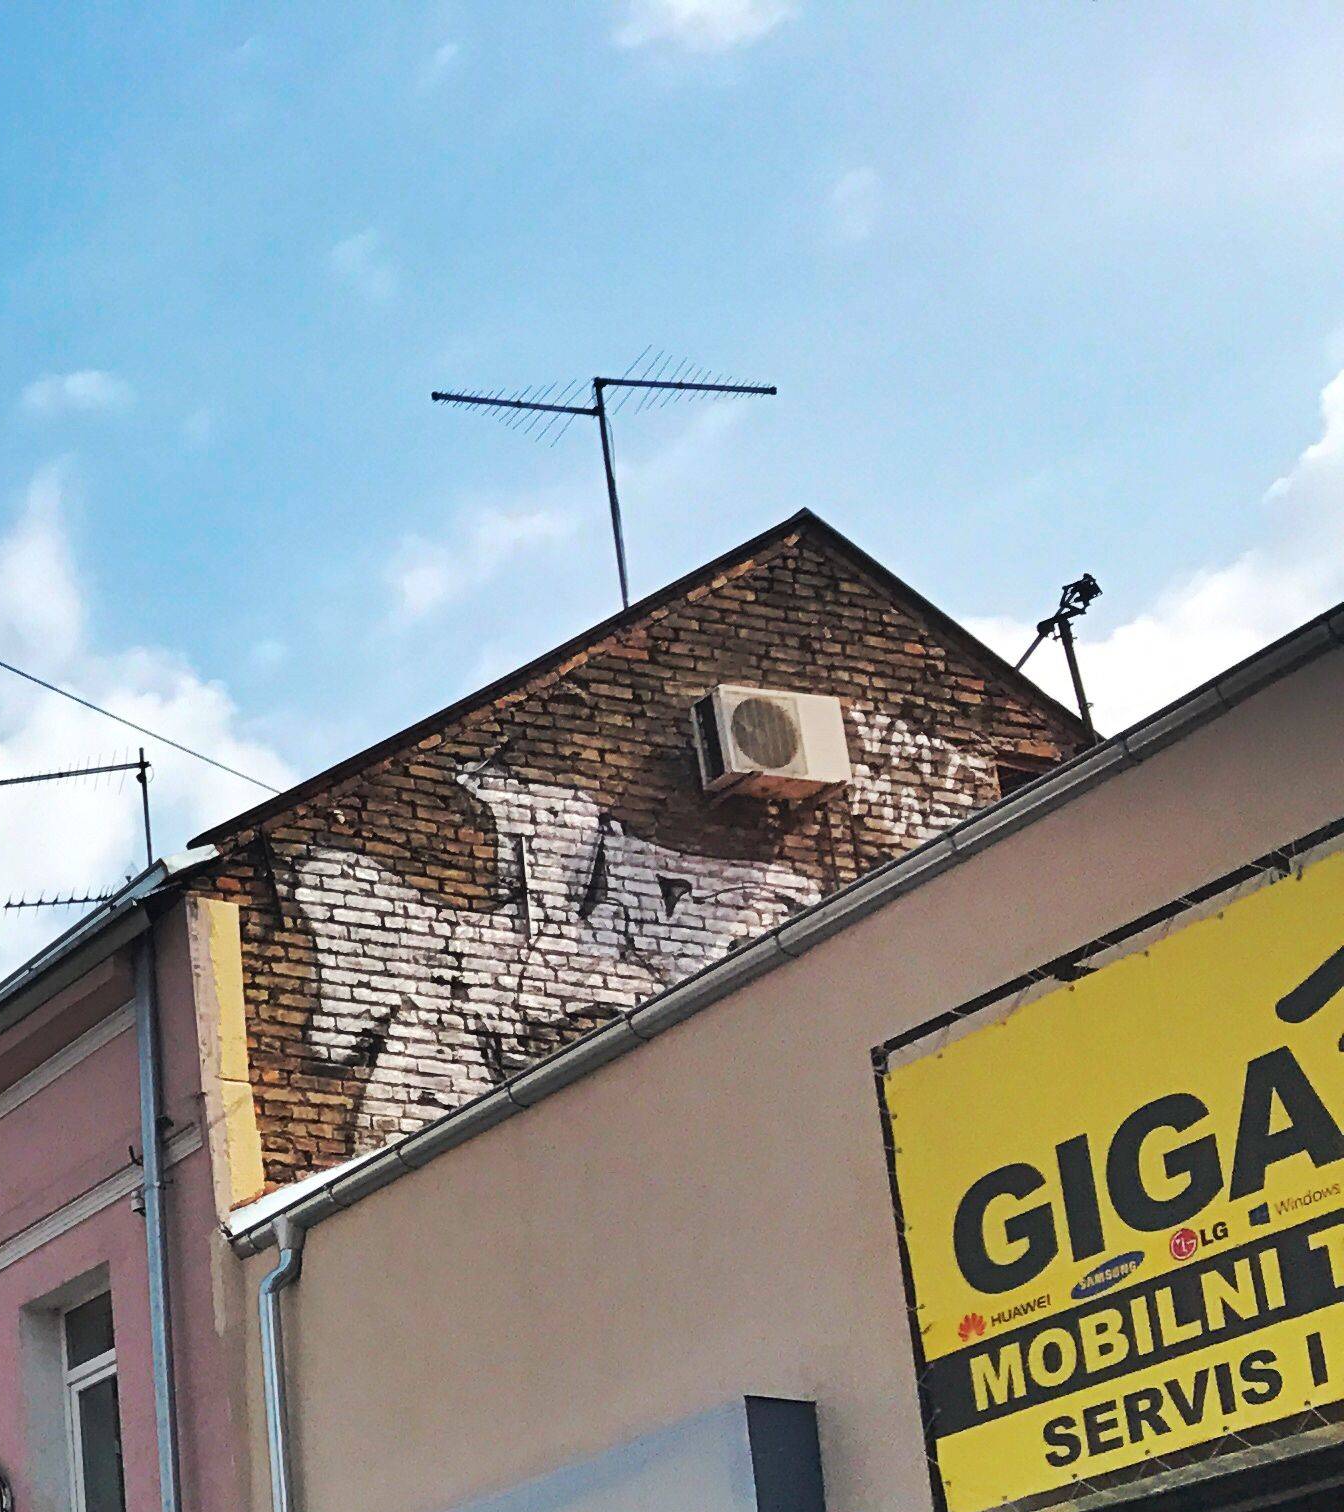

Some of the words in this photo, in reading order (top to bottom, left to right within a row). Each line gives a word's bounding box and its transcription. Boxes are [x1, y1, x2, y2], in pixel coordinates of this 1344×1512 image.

[1273, 1182, 1341, 1216] Windows
[1200, 1221, 1229, 1247] LG
[1077, 1258, 1139, 1292] SAMSUNG
[990, 1293, 1052, 1327] HUAWEI
[970, 1250, 1287, 1411] MOBILNI
[1044, 1349, 1282, 1468] SERVIS
